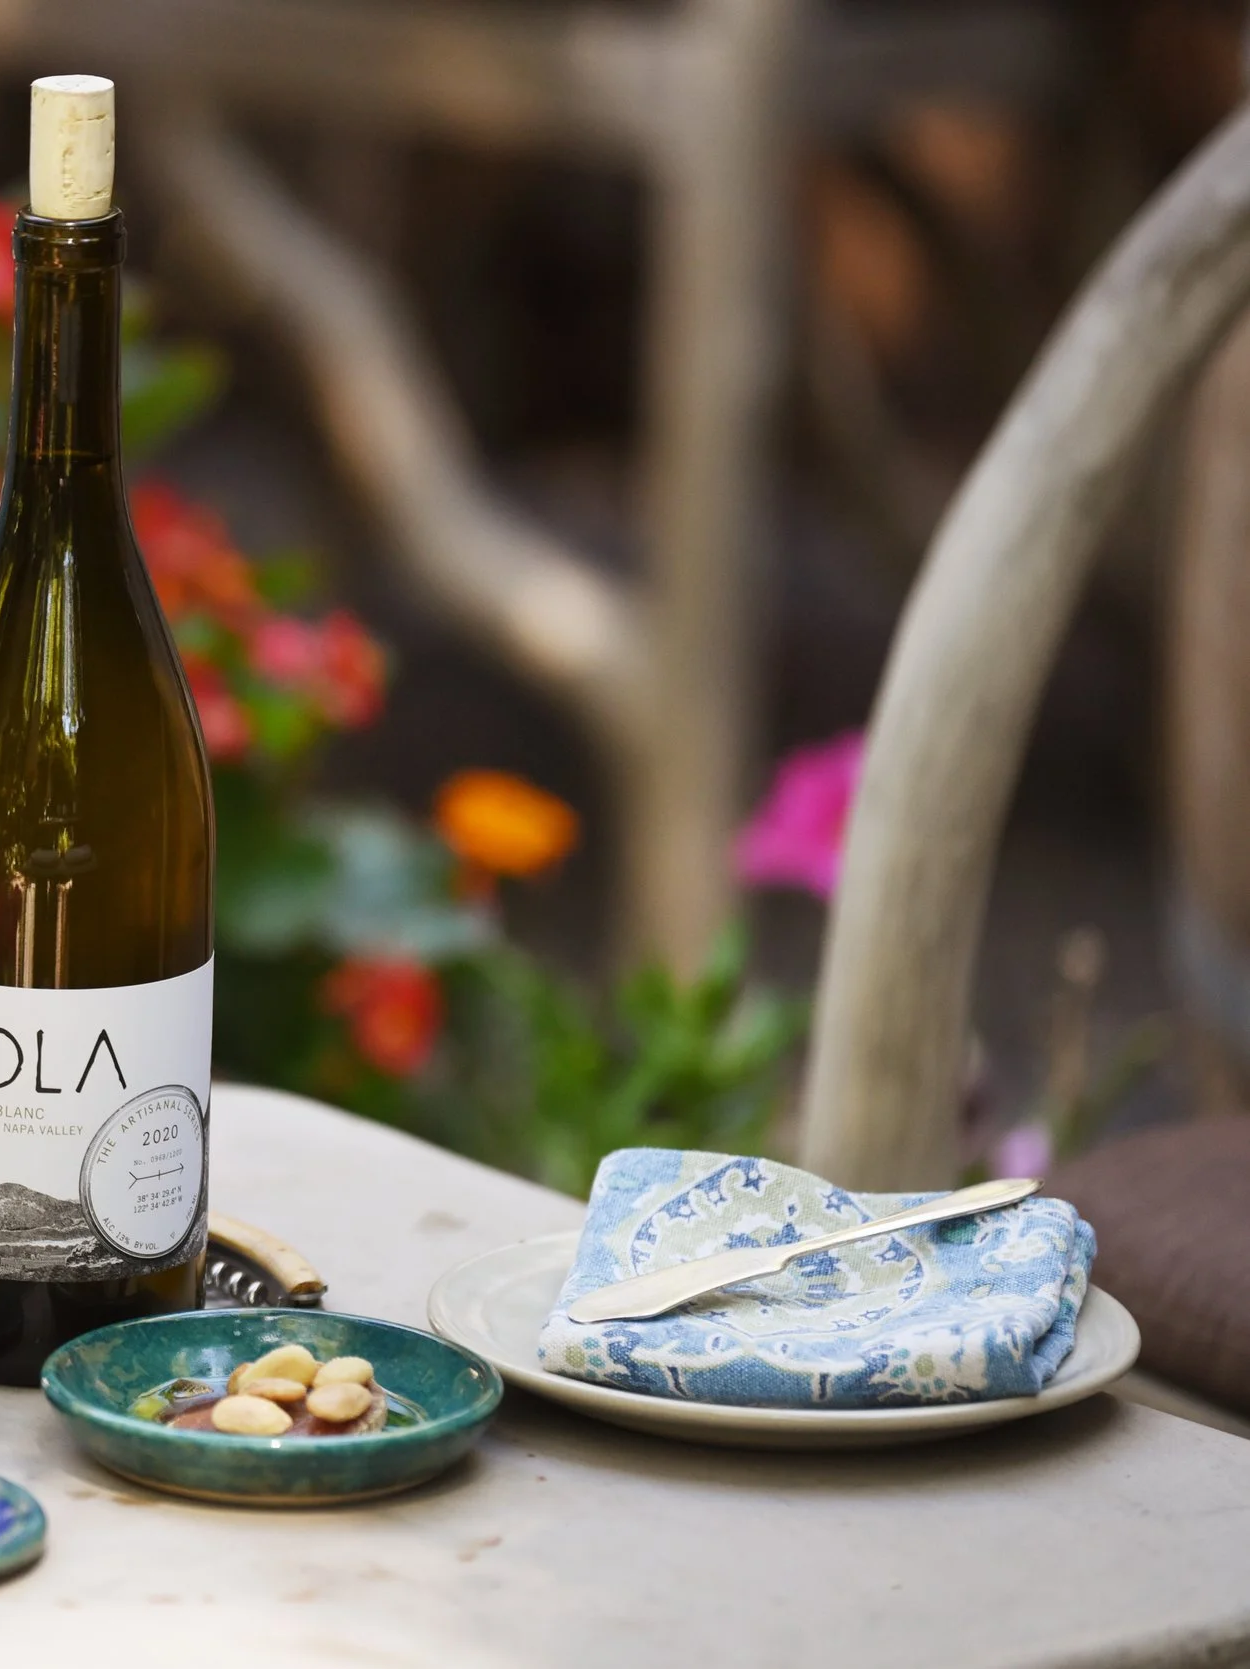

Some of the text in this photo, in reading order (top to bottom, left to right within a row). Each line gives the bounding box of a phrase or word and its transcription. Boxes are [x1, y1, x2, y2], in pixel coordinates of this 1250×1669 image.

[4, 1123, 35, 1135] NAPA
[39, 1125, 83, 1136] VALLEY
[97, 1099, 200, 1165] THE ARTISANAL SERIES
[142, 1124, 179, 1147] 2020
[115, 1231, 130, 1245] 13%
[133, 1240, 143, 1250] BY
